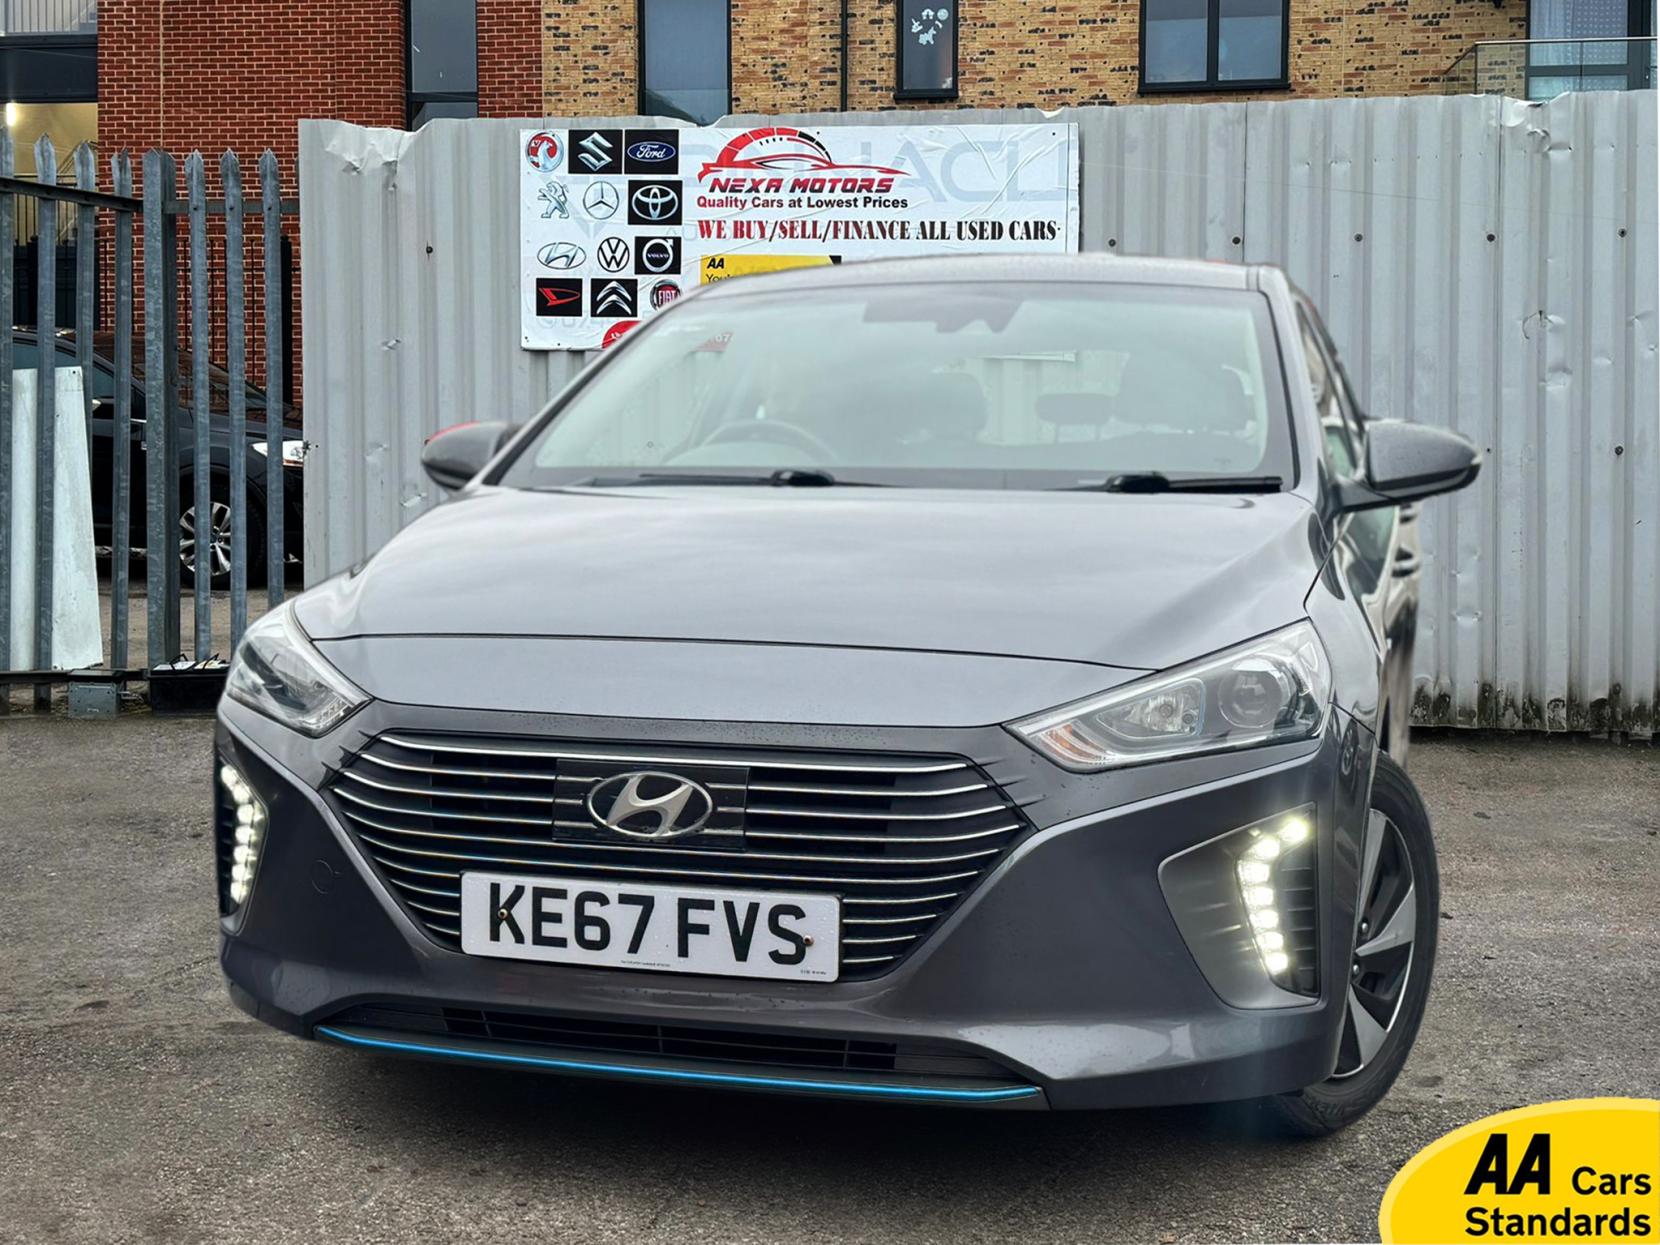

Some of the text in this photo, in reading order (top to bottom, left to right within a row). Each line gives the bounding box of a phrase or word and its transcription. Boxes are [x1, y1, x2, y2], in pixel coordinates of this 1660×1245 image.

[636, 144, 666, 158] Ford
[709, 178, 895, 193] NEXA MOTORS
[697, 196, 909, 210] Quality Cars at Lowest Prices
[697, 220, 727, 239] WE
[916, 220, 951, 240] ALL
[956, 220, 1004, 240] USED
[1009, 220, 1057, 240] CARS
[706, 257, 725, 269] AA
[489, 882, 806, 965] KE67 FVS
